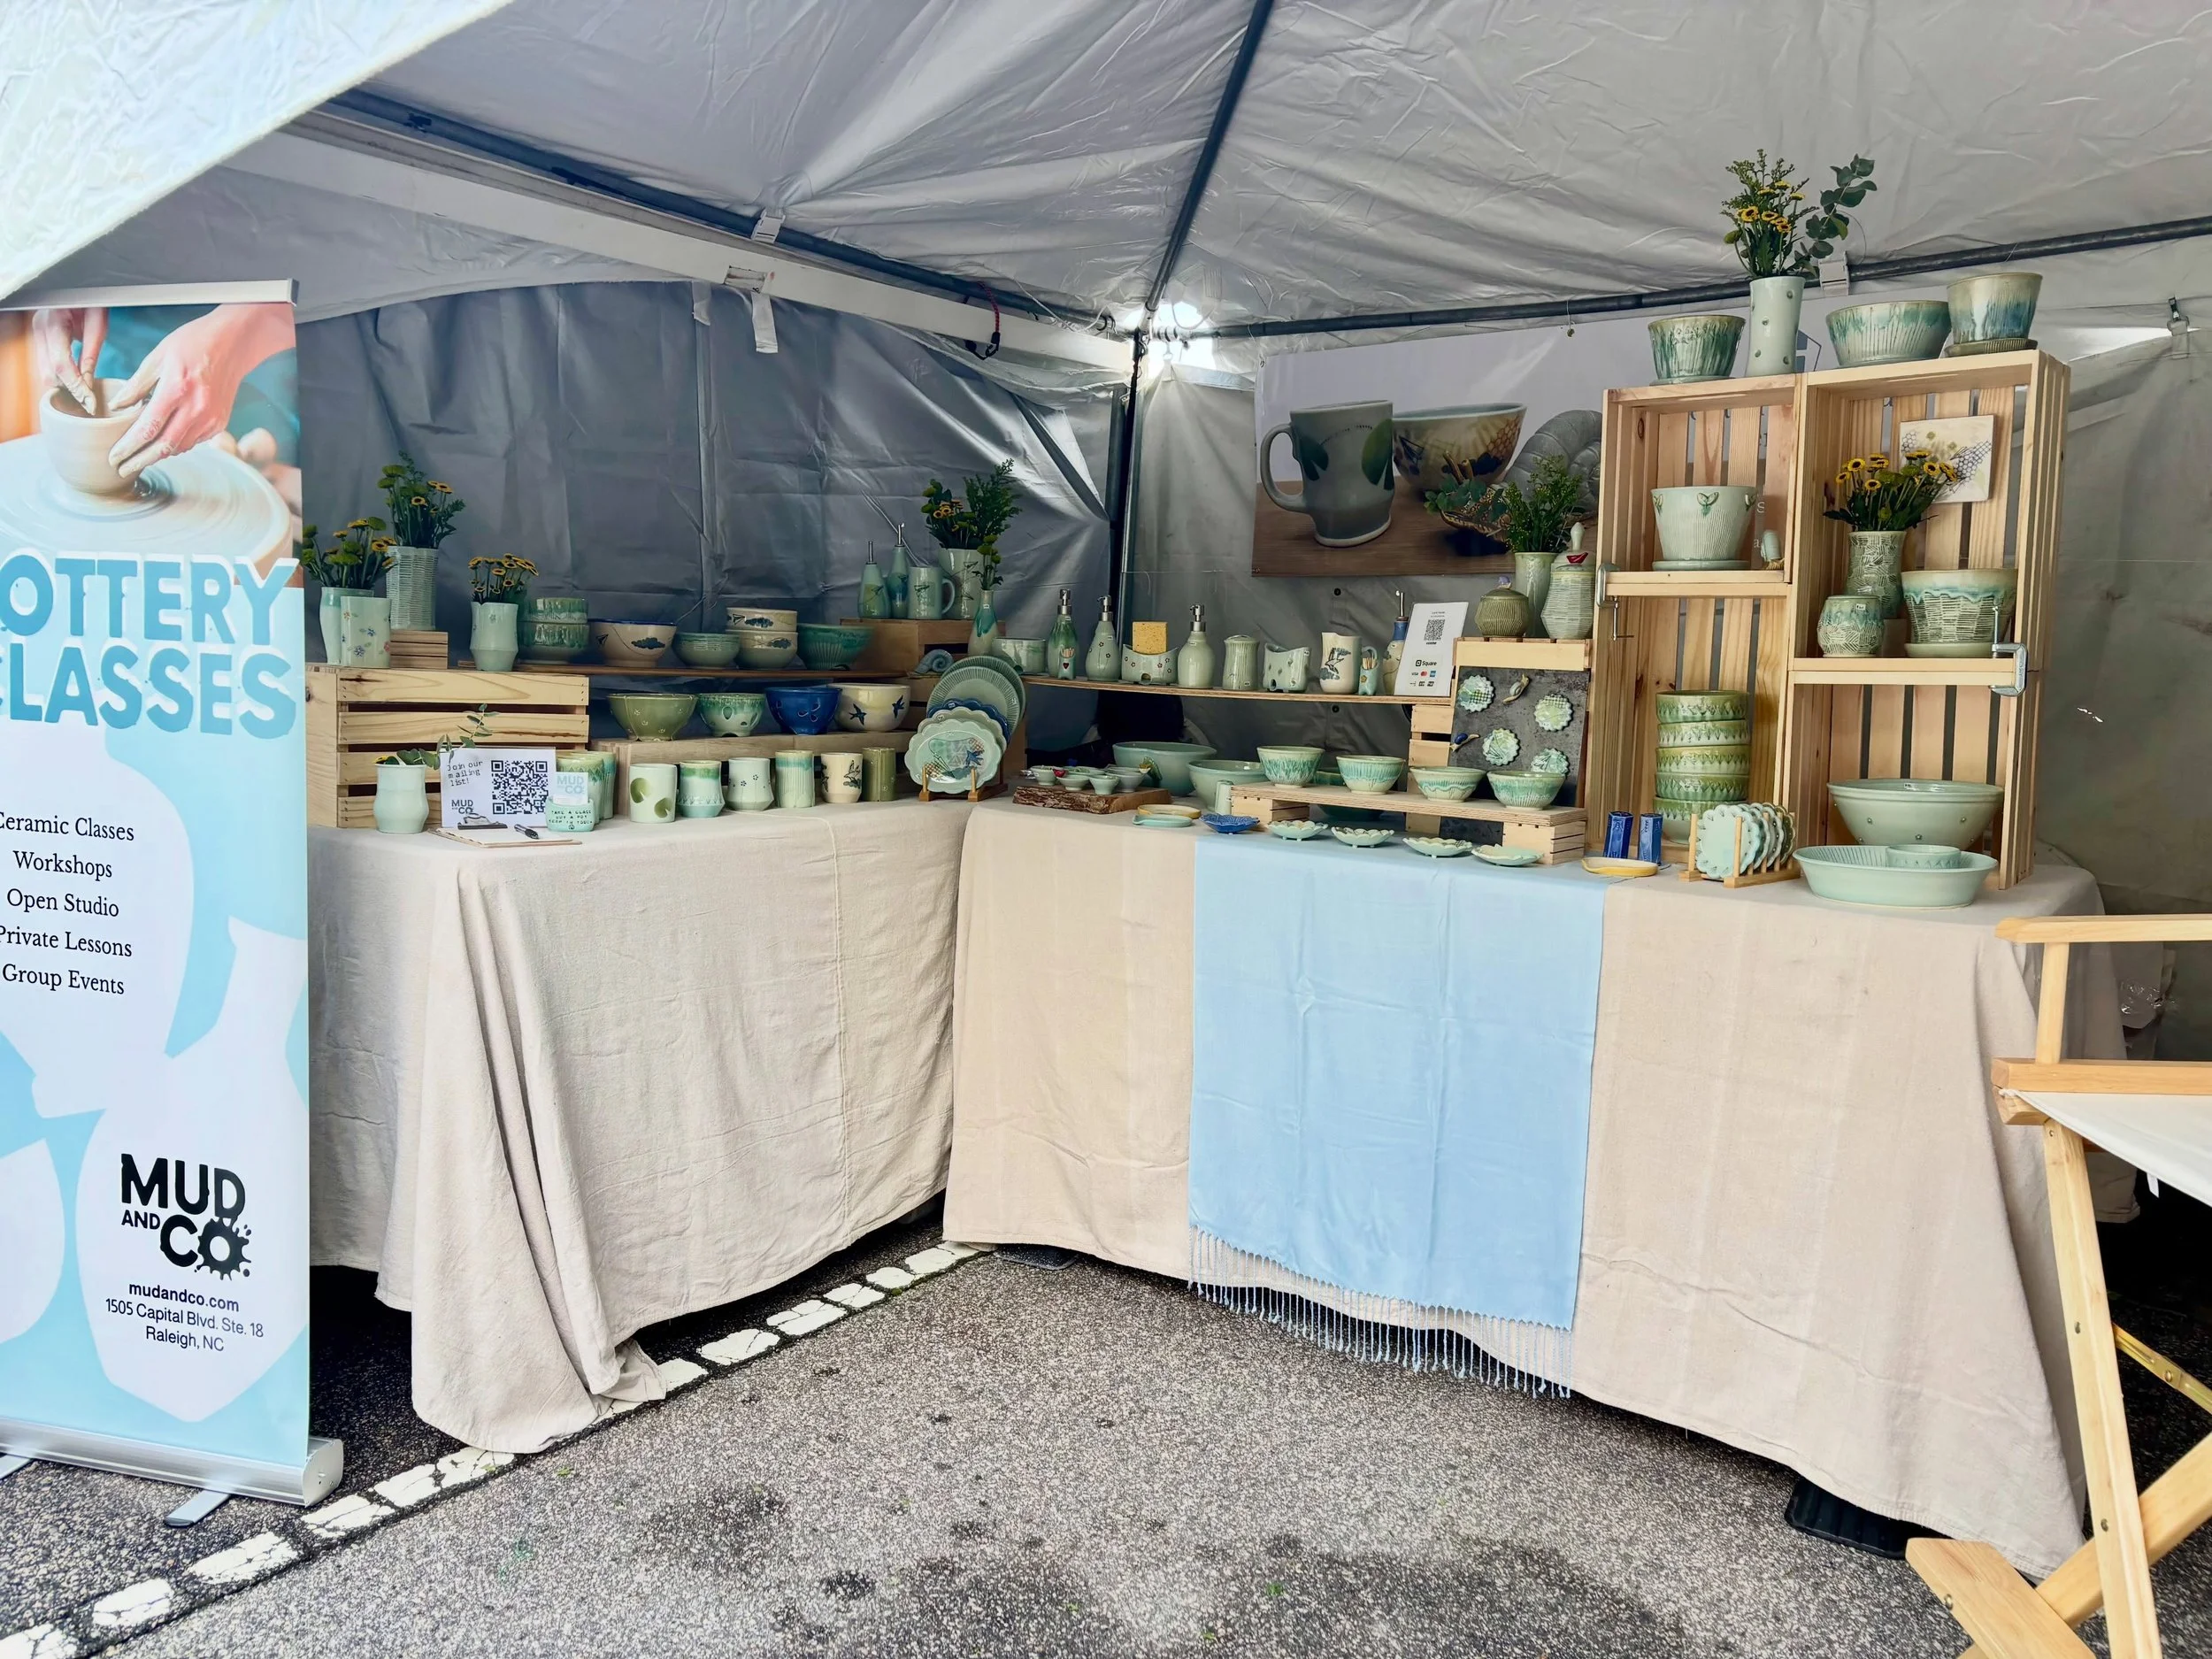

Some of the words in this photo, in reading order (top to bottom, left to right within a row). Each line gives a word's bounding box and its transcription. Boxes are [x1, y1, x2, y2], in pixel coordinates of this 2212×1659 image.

[0, 642, 297, 740] LASSES
[447, 763, 465, 772] Join
[448, 769, 480, 780] mailing
[557, 775, 584, 785] MUD
[450, 778, 470, 787] list!
[565, 785, 585, 795] CO
[75, 818, 134, 841] Classes
[12, 850, 112, 881] Workshops
[7, 888, 58, 912] Open
[64, 893, 119, 917] Studio
[65, 931, 132, 956] Lessons
[3, 964, 62, 991] Group
[68, 970, 125, 995] Events
[121, 1153, 246, 1217] MUD
[121, 1210, 161, 1230] AND
[159, 1214, 253, 1281] CO
[129, 1283, 239, 1312] mudandco.com
[105, 1298, 134, 1316] 1505
[136, 1303, 184, 1324] Capital
[187, 1311, 219, 1330] Blvd.
[221, 1317, 247, 1335] Ste.
[250, 1322, 264, 1338] 18
[146, 1325, 200, 1350] Raleigh,
[203, 1337, 224, 1352] NC
